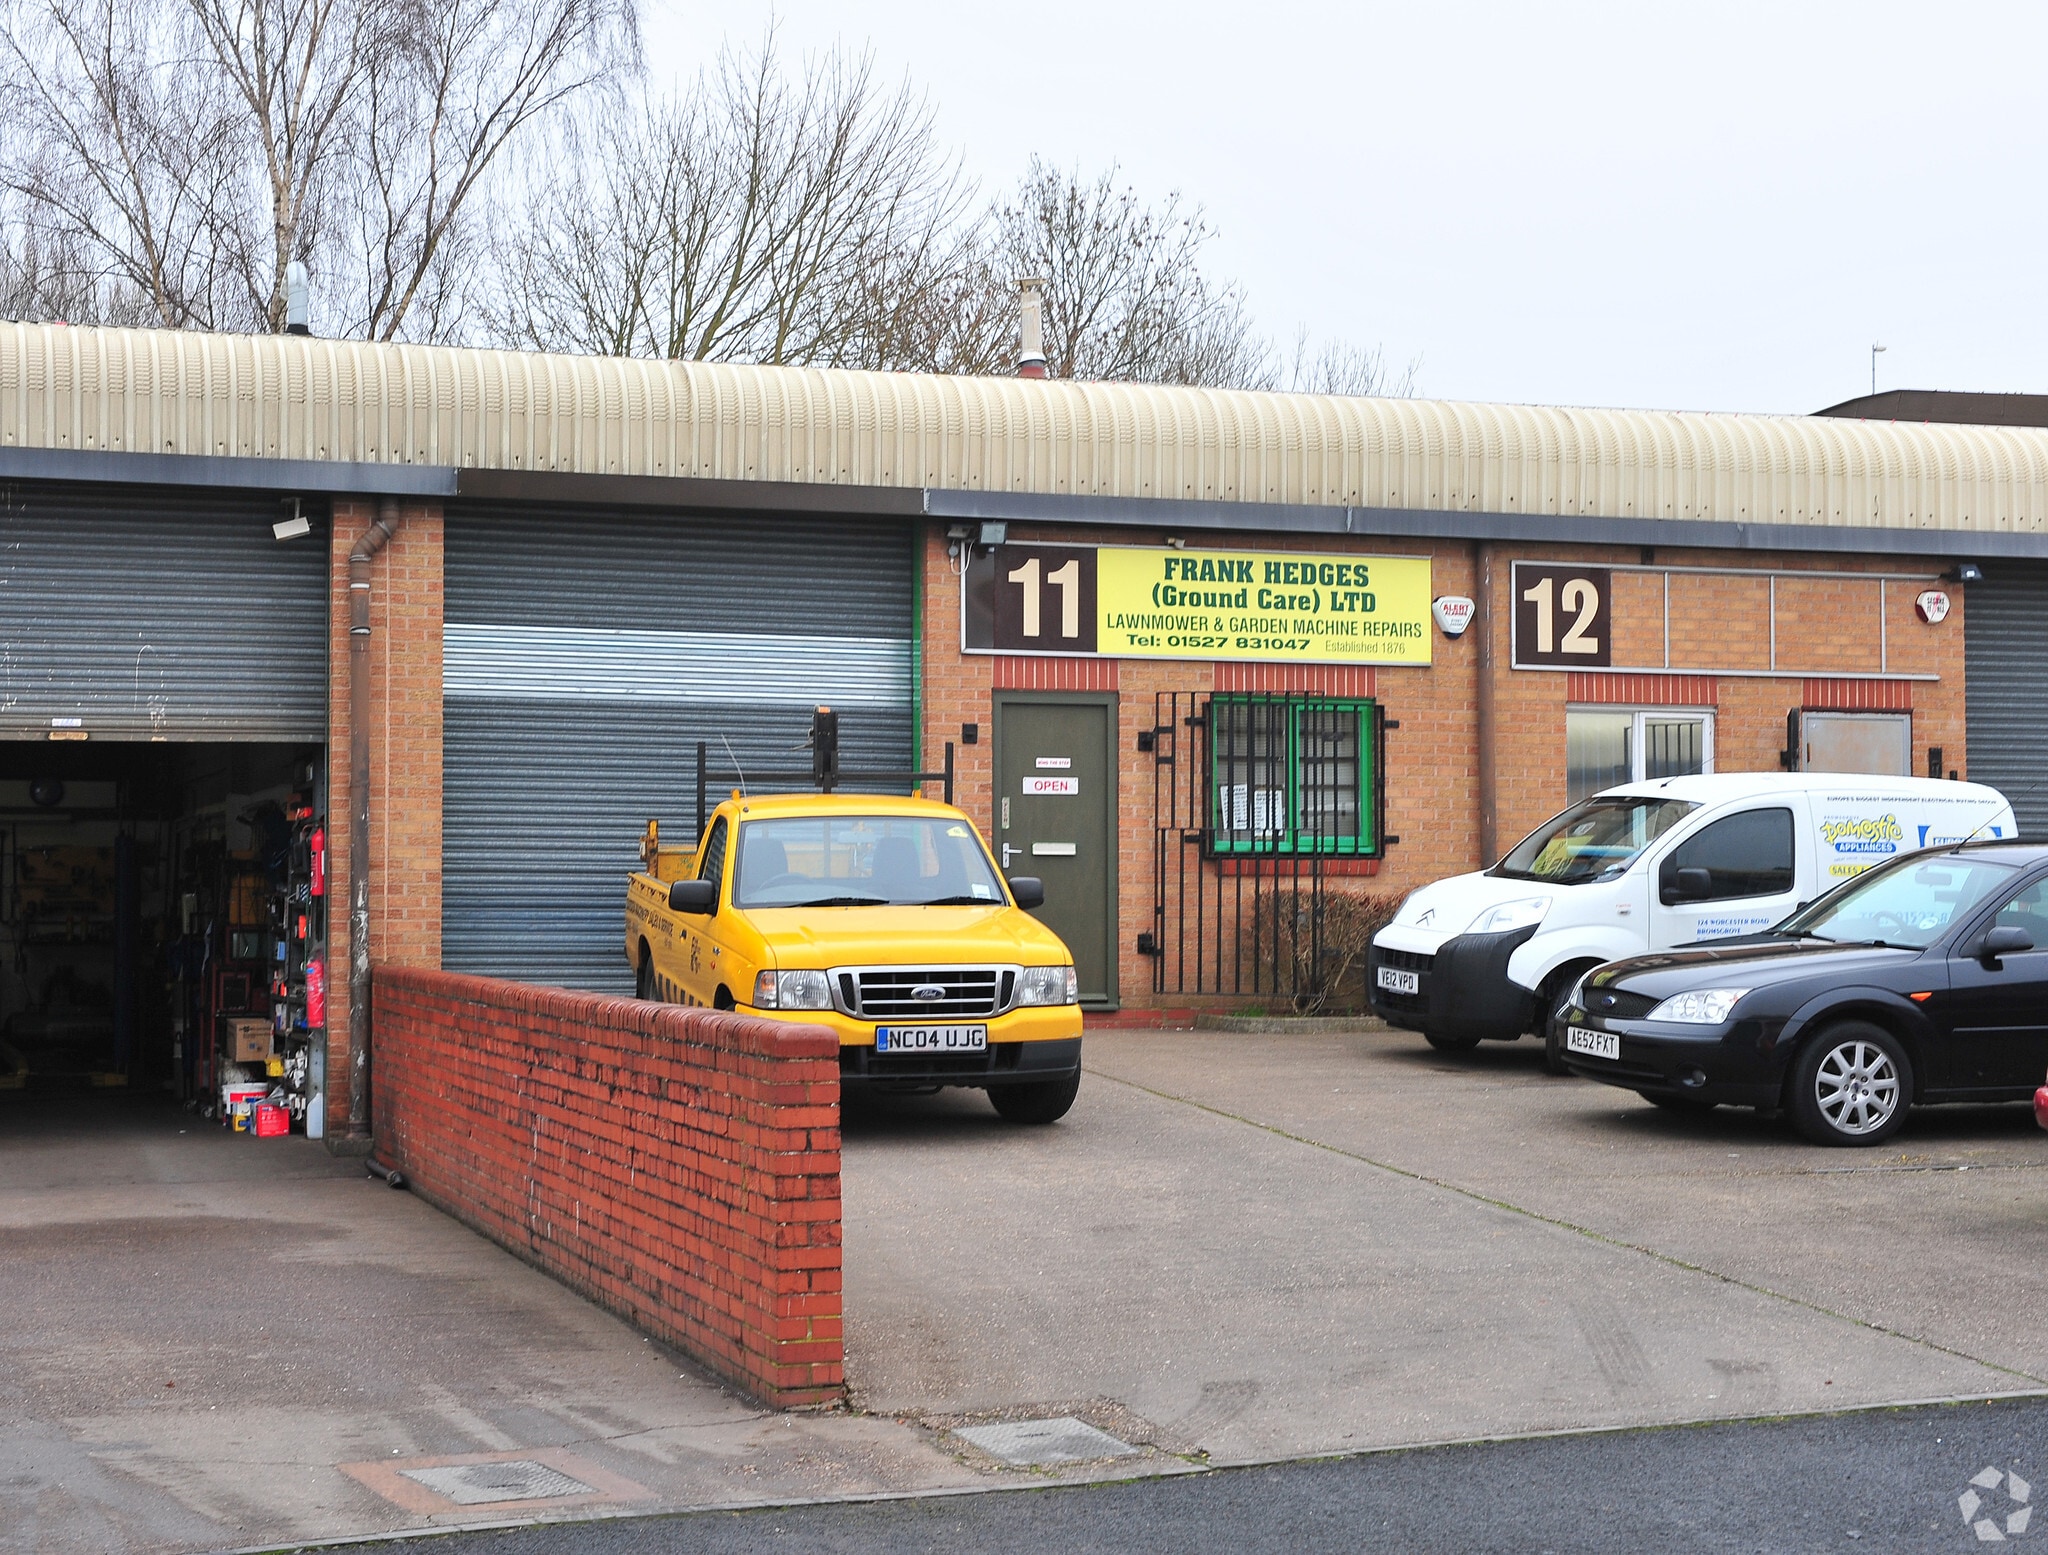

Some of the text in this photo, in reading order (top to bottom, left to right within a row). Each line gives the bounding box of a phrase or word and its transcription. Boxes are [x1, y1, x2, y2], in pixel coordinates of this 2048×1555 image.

[1164, 557, 1369, 587] FRANK HEDGES
[1008, 558, 1079, 638] 11
[1152, 582, 1376, 614] (Ground Care) LTD
[1107, 613, 1422, 638] LAWNMOWER & GARDEN MACHINE REPAIRS
[1524, 577, 1599, 654] 12
[1126, 634, 1406, 655] Tel: 01527 831047 Established 1876
[1034, 781, 1068, 791] OPEN
[1840, 843, 1893, 852] APPLIANCES
[889, 1030, 983, 1048] NC04 UJG
[1571, 1029, 1616, 1055] AE52 FXT
